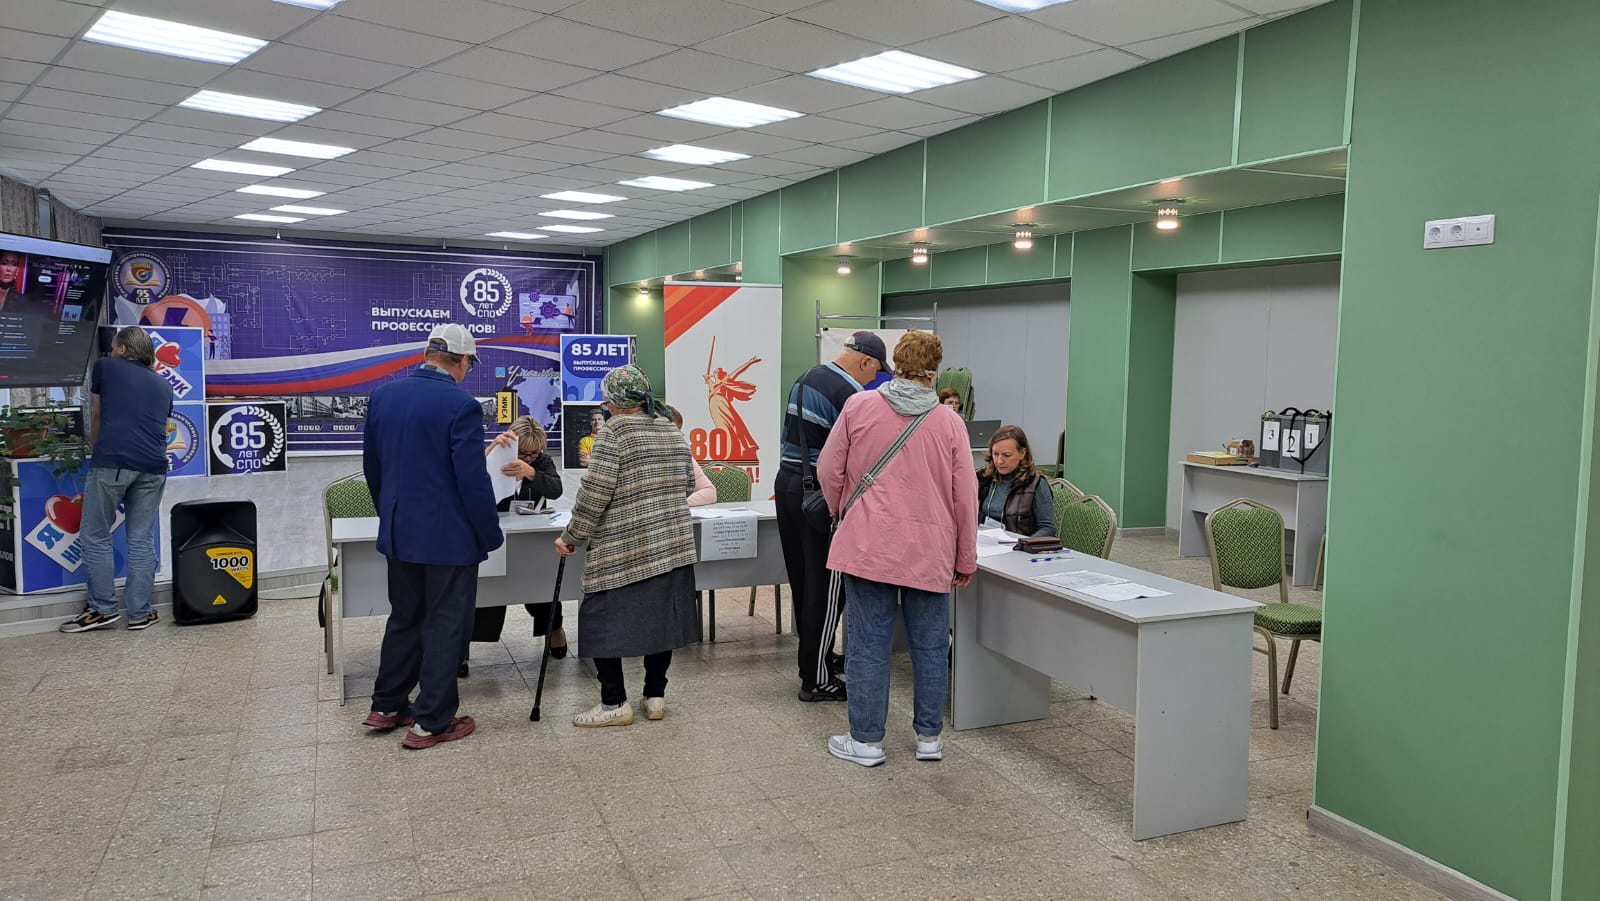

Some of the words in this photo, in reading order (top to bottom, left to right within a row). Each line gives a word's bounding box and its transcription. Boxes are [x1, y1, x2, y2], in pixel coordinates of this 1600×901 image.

[136, 289, 150, 298] 95
[473, 280, 500, 302] 85
[478, 302, 495, 310] лет
[371, 307, 451, 319] ВЫПУСКАЕМ
[477, 309, 496, 319] СПО
[571, 343, 592, 356] 85
[594, 343, 628, 356] ЛЕТ
[230, 421, 266, 450] 85
[1268, 429, 1275, 440] 3
[1307, 433, 1313, 444] 1
[690, 428, 728, 460] 80
[1286, 435, 1296, 453] 2
[238, 450, 260, 458] лет
[236, 458, 262, 470] СПО
[36, 523, 65, 550] Я
[61, 537, 82, 565] НА
[211, 556, 249, 569] 1000
